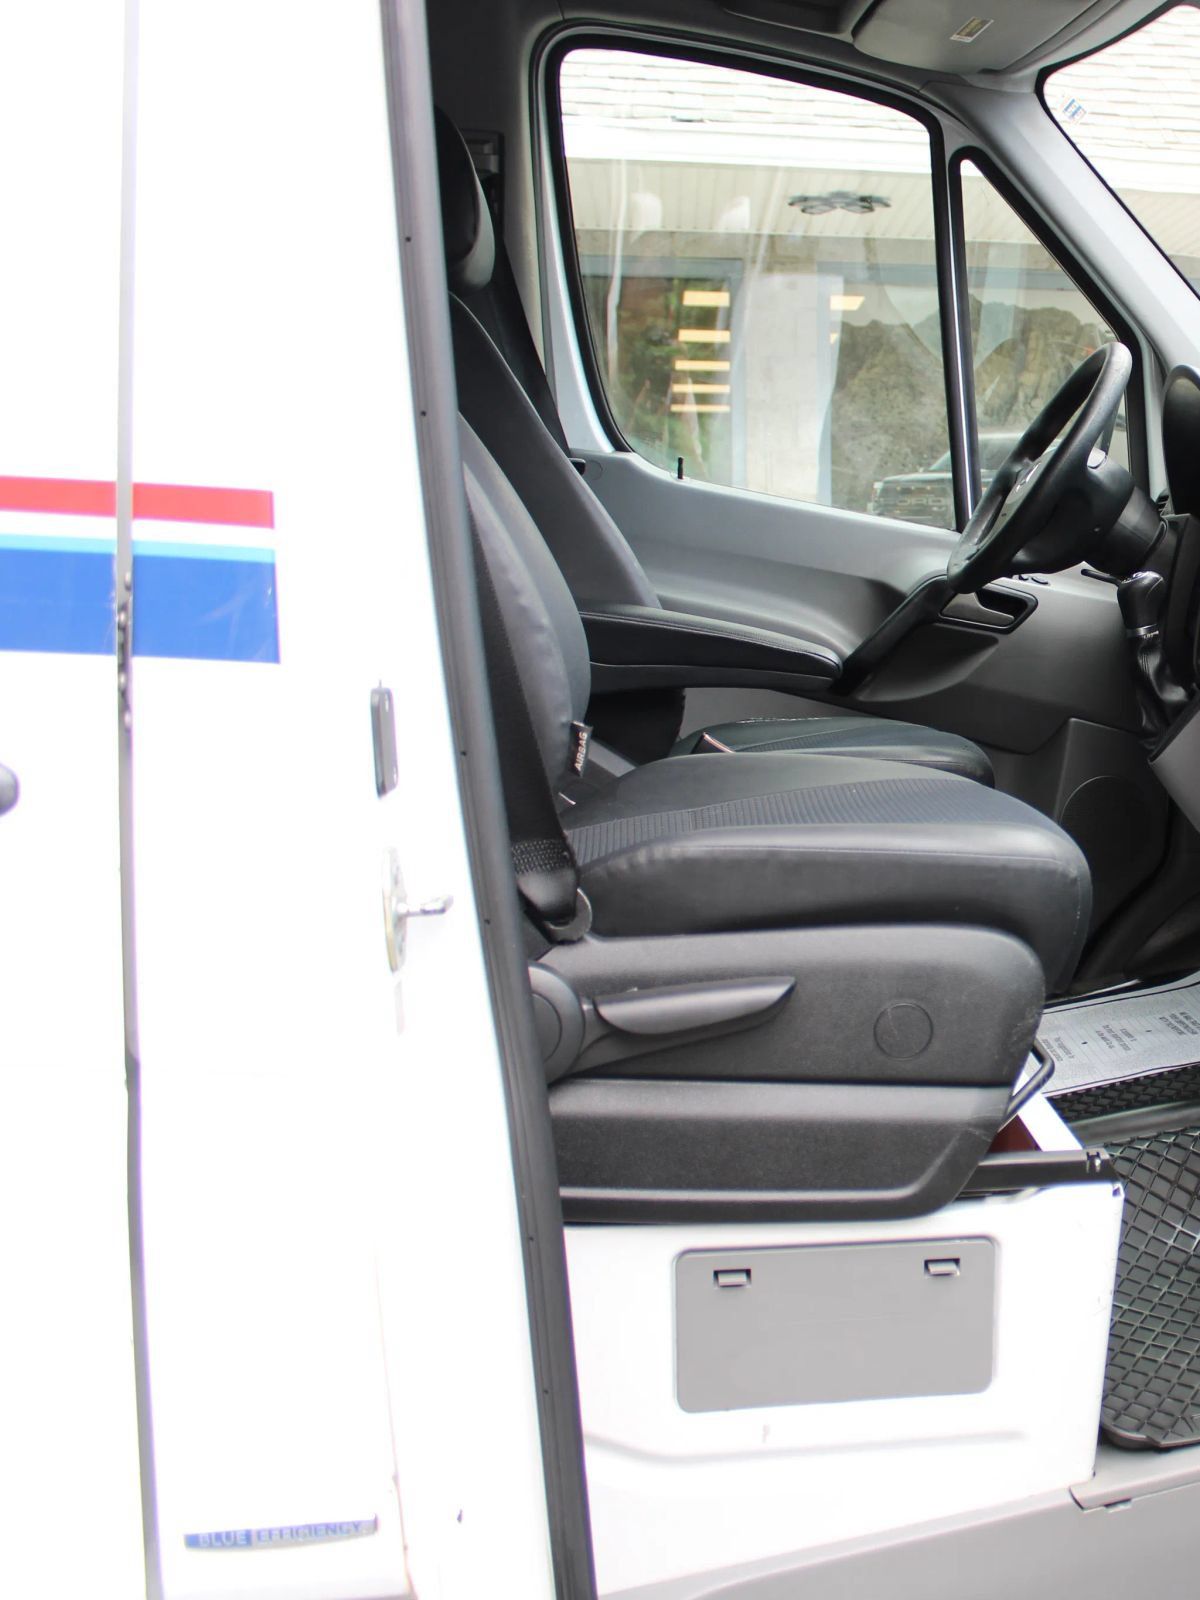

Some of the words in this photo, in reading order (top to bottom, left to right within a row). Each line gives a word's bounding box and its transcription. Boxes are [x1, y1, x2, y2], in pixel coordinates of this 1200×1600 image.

[574, 732, 587, 771] AIRBAG
[199, 1530, 247, 1548] BLUE
[257, 1522, 361, 1542] EFFICIENCY
